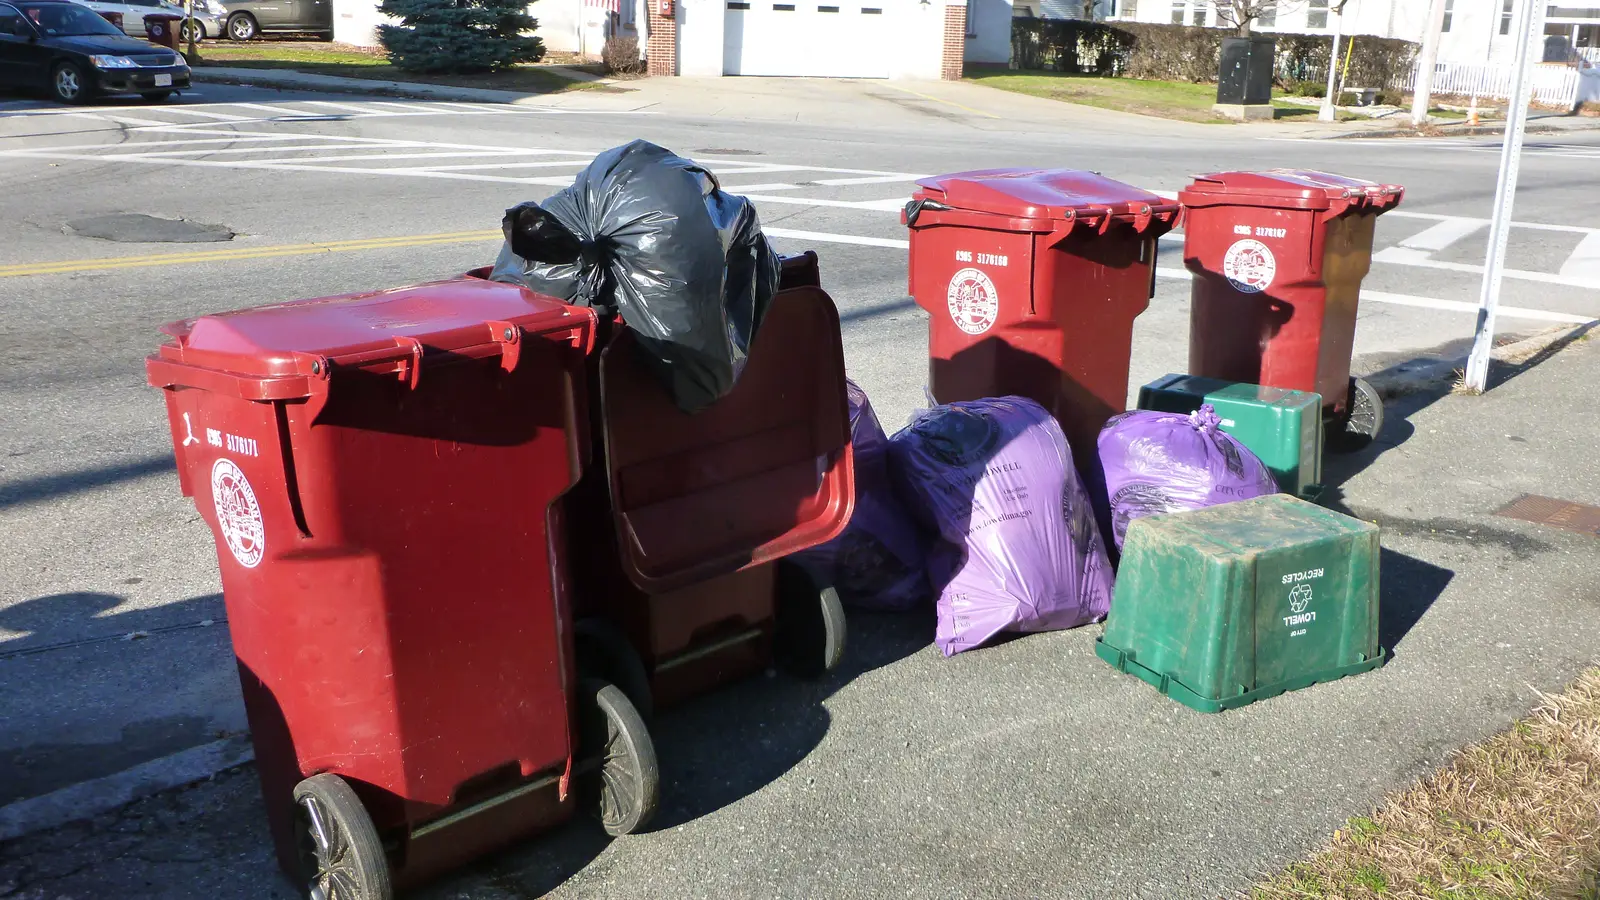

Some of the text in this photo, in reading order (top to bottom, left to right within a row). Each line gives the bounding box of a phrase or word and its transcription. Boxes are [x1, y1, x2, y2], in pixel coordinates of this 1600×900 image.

[226, 434, 258, 457] 3176171
[1281, 568, 1324, 584] RECYCLES
[1283, 612, 1316, 626] LOWELL
